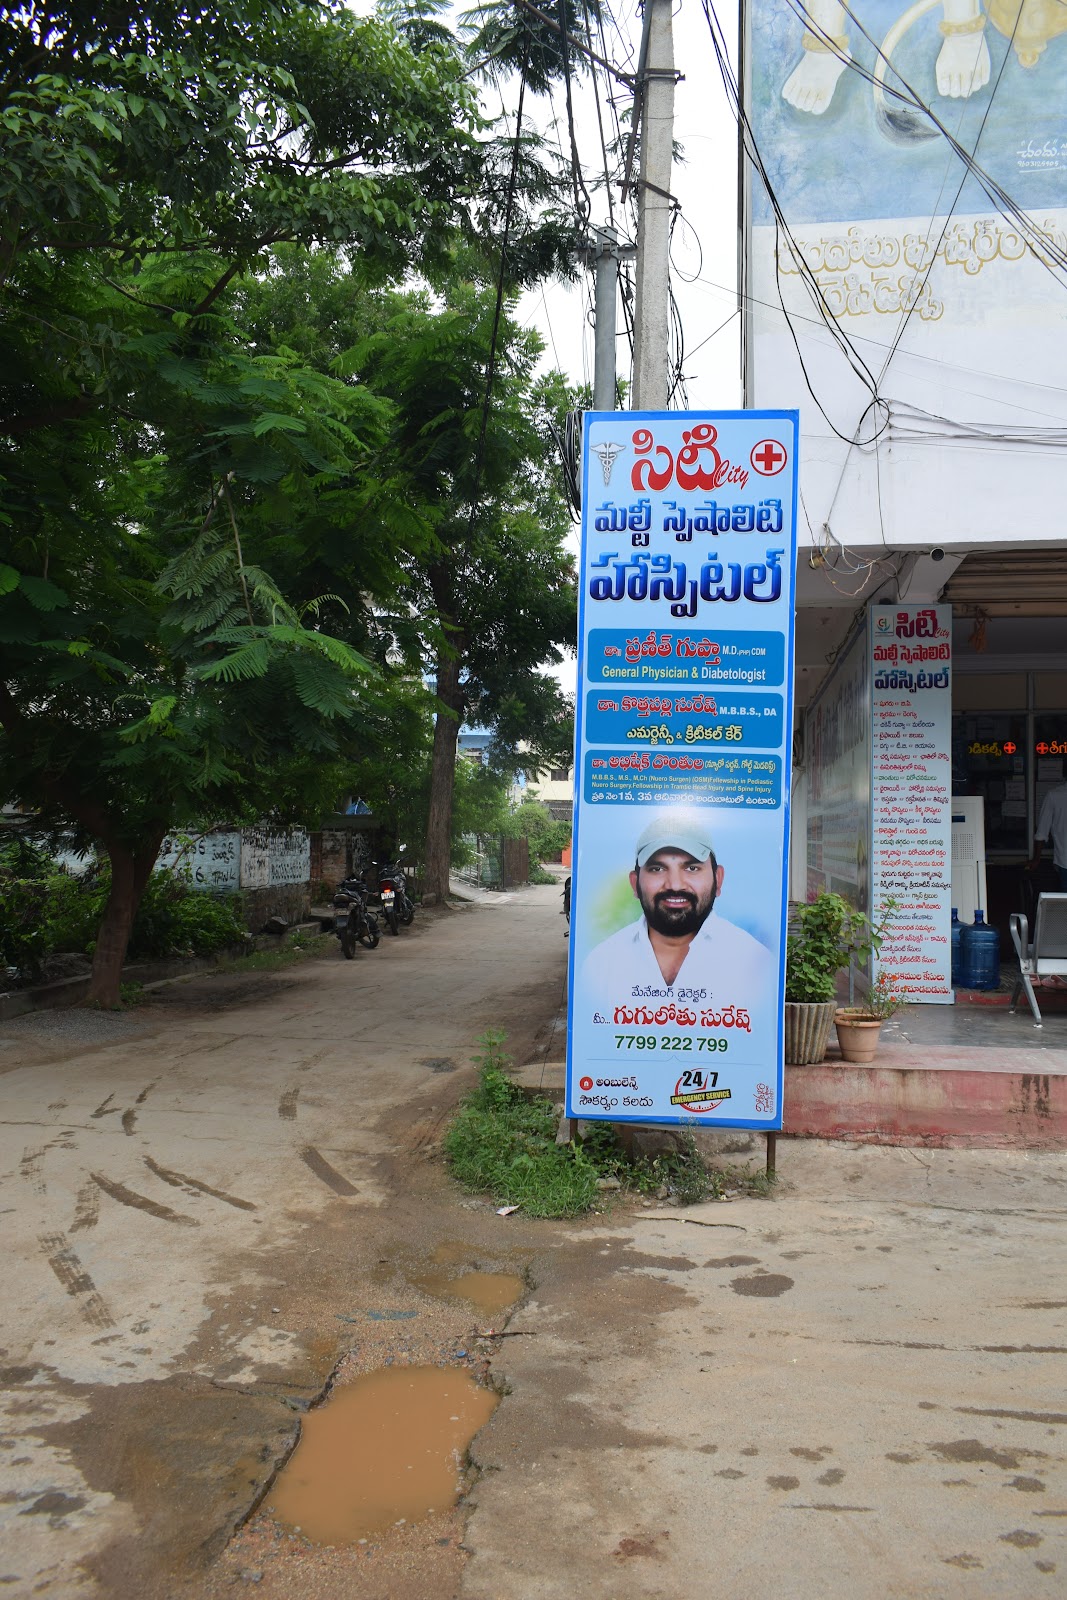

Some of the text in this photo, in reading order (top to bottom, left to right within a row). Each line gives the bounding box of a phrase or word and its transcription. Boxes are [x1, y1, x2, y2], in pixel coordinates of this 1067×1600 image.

[713, 459, 749, 491] City
[595, 497, 652, 547] మల్టీ
[933, 627, 950, 639] City
[625, 630, 672, 664] ప్రణీత్
[676, 636, 721, 665] గుప్తా
[751, 647, 766, 656] CDM
[873, 643, 898, 667] మల్టీ
[602, 665, 766, 683] General Physician & Diabetologist
[621, 695, 673, 717] కొత్తపల్లి
[675, 693, 718, 716] సురేష్
[763, 707, 777, 716] DA
[684, 724, 723, 744] క్రిటికల్
[725, 724, 743, 740] కేర్
[609, 752, 651, 772] అభిషేక్
[737, 785, 754, 793] Spine
[755, 786, 771, 794] Injury
[631, 985, 674, 998] మేనేజింగ్
[677, 988, 708, 1003] డైరెక్టర్
[613, 1003, 697, 1027] గుగులోతు
[700, 1004, 752, 1033] సురేష్
[614, 1035, 729, 1052] 7799 222 799
[622, 1095, 654, 1107] కలదు
[671, 1090, 731, 1104] EMERGENCY SERVICE
